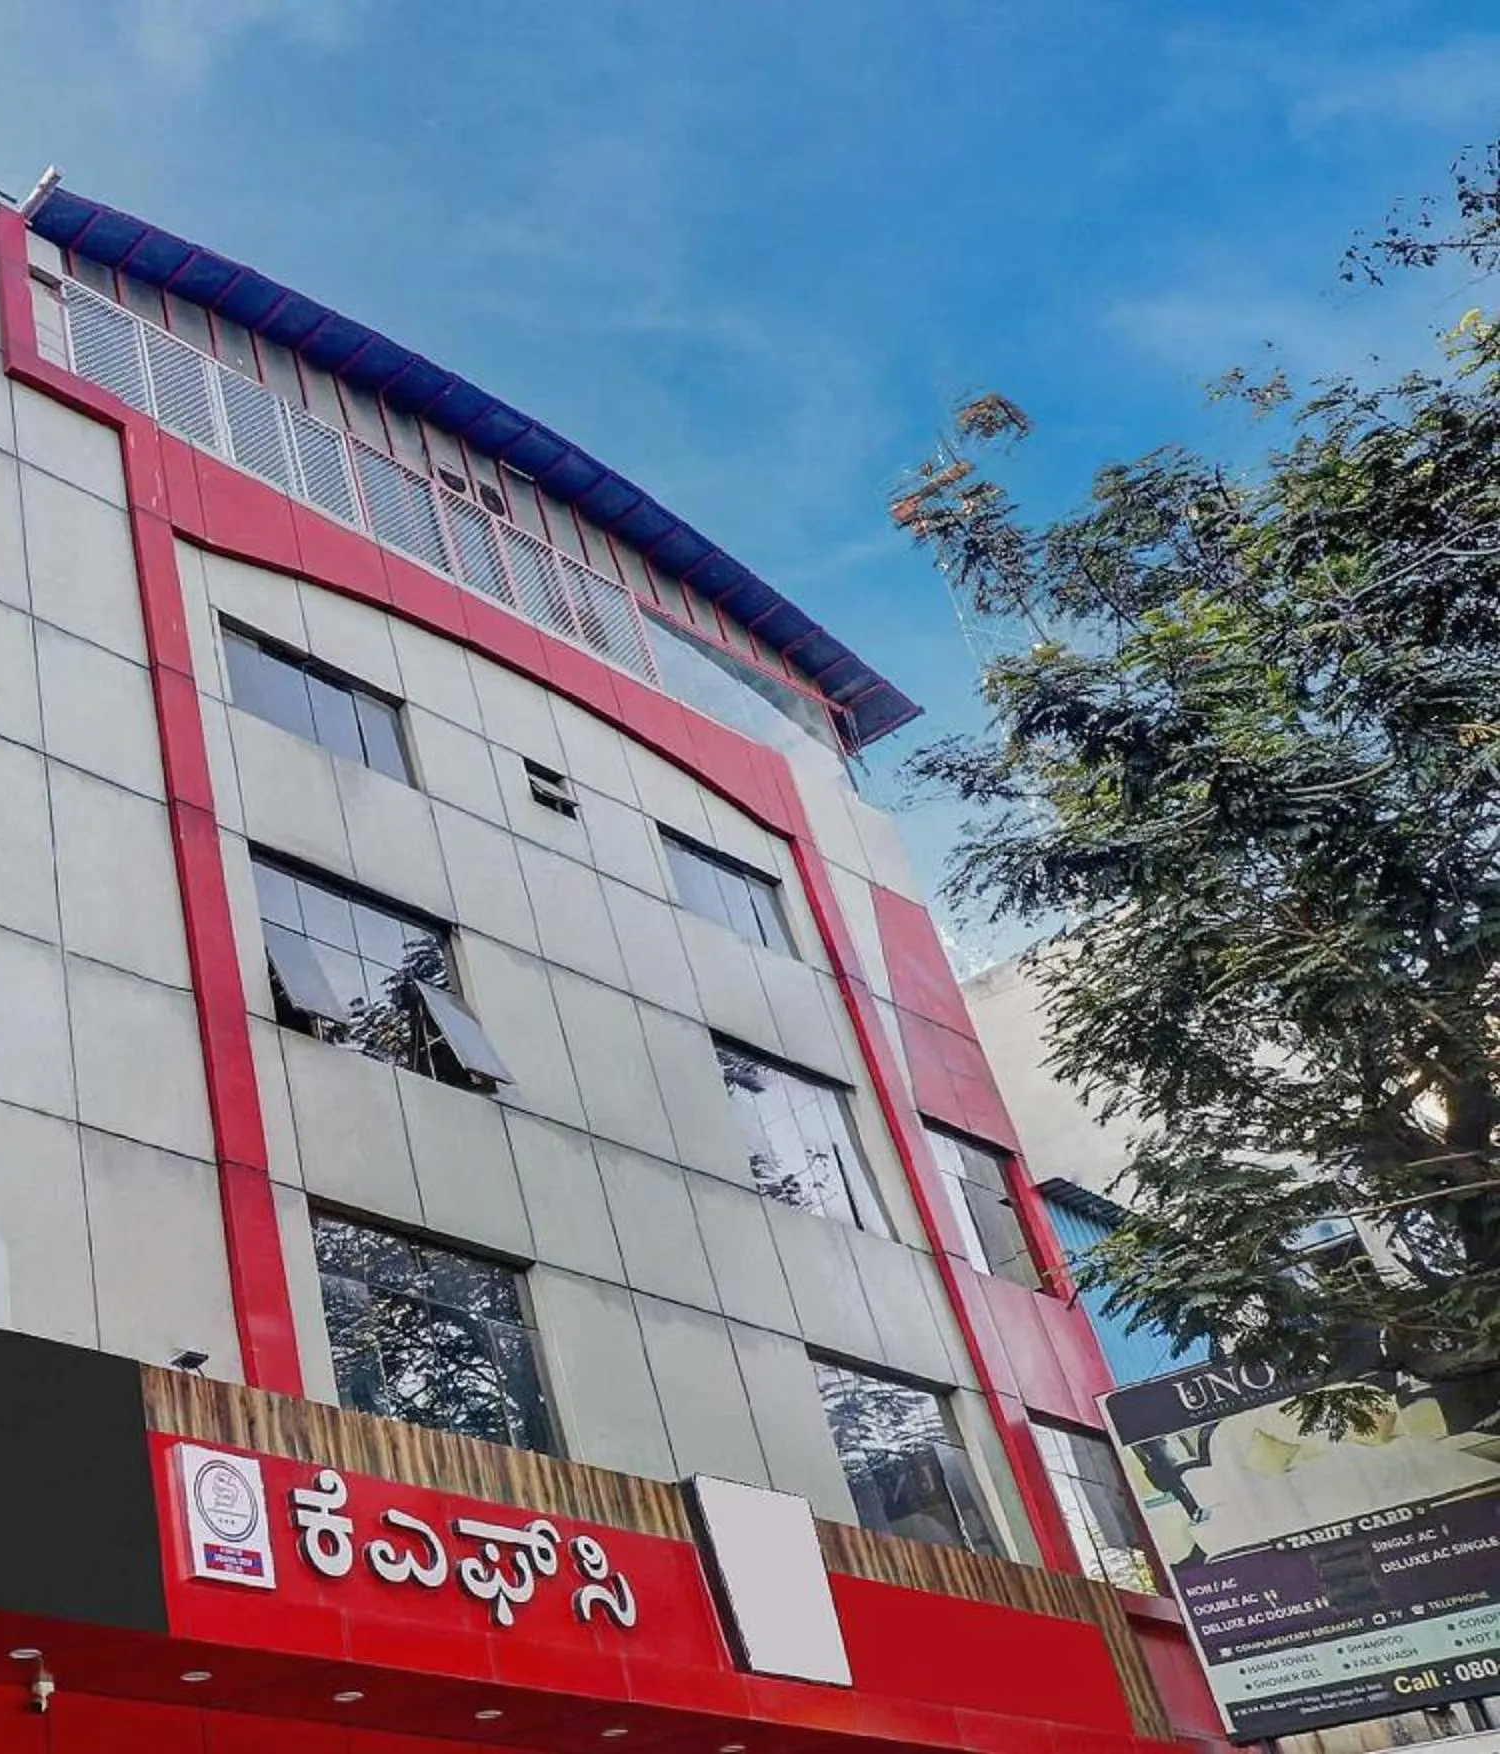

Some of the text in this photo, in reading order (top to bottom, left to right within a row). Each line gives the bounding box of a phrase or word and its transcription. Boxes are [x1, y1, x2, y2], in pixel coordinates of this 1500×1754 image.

[1172, 1359, 1276, 1411] UNO
[1286, 1507, 1413, 1549] TARIFF CARD
[1371, 1529, 1437, 1553] SINGLE AC
[1380, 1535, 1500, 1573] DELUXE AC SINGLE
[1221, 1577, 1238, 1590] AC
[1193, 1593, 1259, 1616] DOUBLE AC
[1428, 1590, 1491, 1611] TELEPHONE
[1201, 1601, 1315, 1636] DELUXE AC DOUBLE
[1311, 1617, 1365, 1639] BREAKFAST
[1346, 1634, 1404, 1653] SHAMPOO
[1247, 1653, 1317, 1674] HAND TOWEL
[1352, 1647, 1419, 1668] FACE WASH
[1253, 1668, 1324, 1690] SHOWER GEL
[1393, 1669, 1440, 1694] Call
